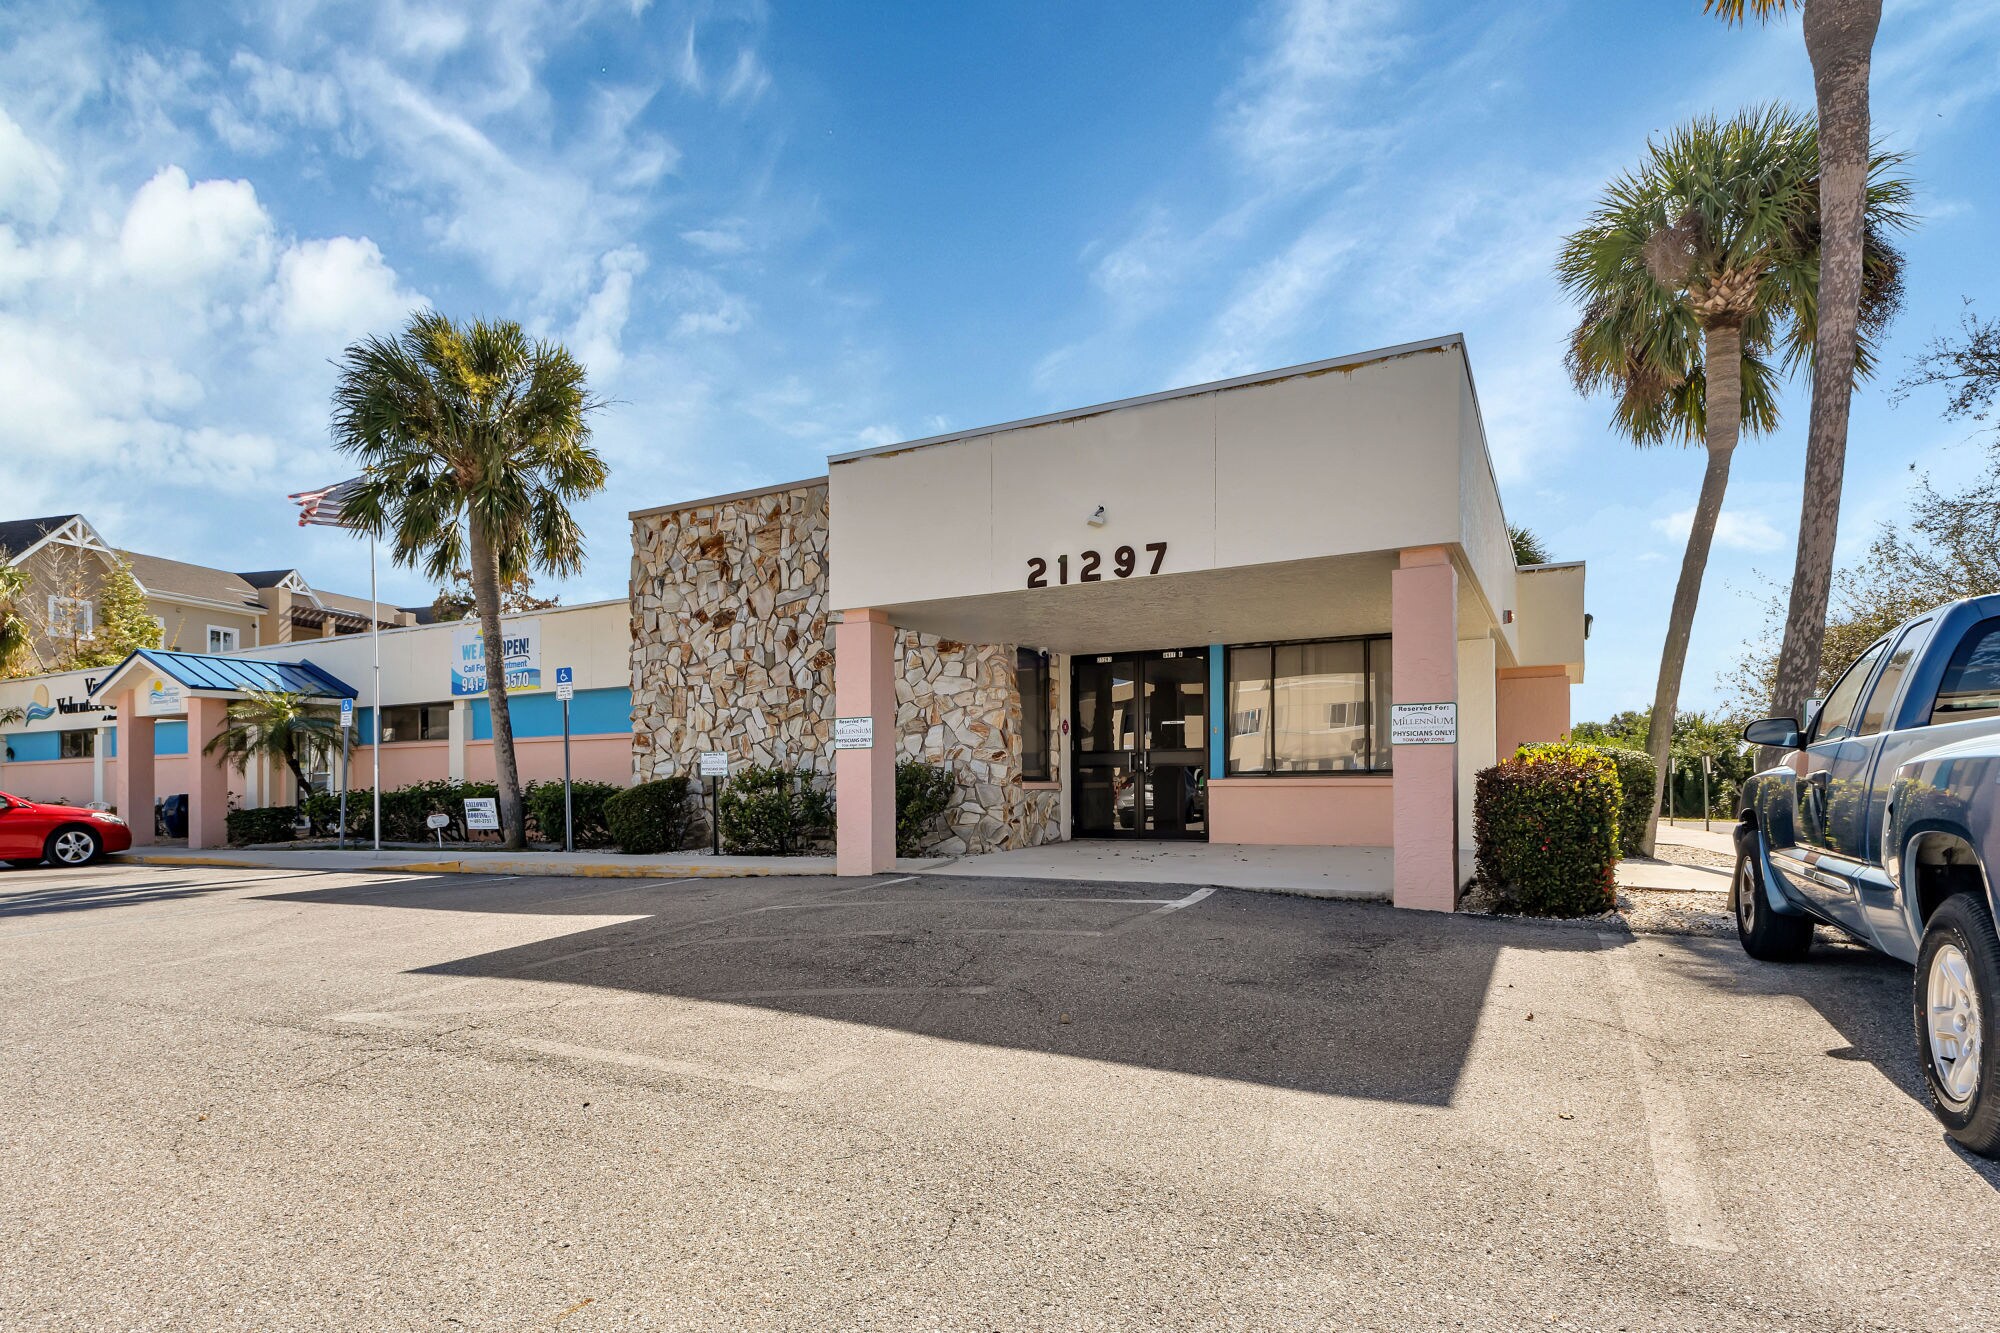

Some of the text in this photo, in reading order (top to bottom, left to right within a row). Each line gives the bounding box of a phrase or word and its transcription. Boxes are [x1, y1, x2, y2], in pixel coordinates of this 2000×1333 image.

[1026, 541, 1168, 589] 21297
[462, 644, 477, 660] WE
[464, 665, 475, 673] Call
